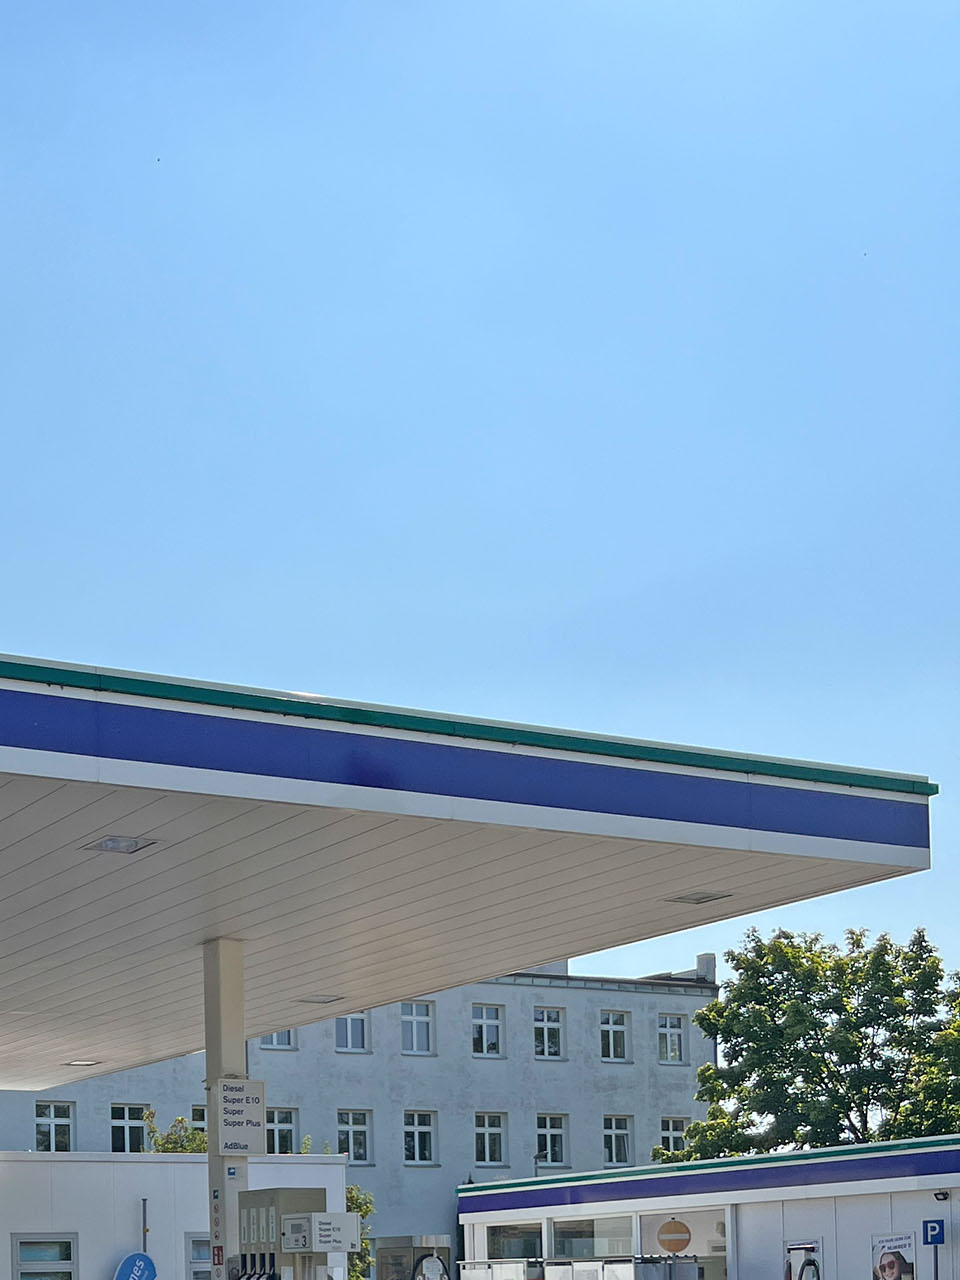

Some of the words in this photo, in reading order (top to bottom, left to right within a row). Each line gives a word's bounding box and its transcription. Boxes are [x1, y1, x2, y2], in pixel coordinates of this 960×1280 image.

[222, 1084, 245, 1093] Diesel
[223, 1095, 244, 1105] Super
[245, 1096, 260, 1104] E10
[223, 1107, 244, 1116] Super
[223, 1118, 245, 1128] Super
[245, 1119, 261, 1128] Plus
[223, 1142, 249, 1150] AdBlue
[927, 1222, 940, 1242] P
[301, 1235, 307, 1247] 3
